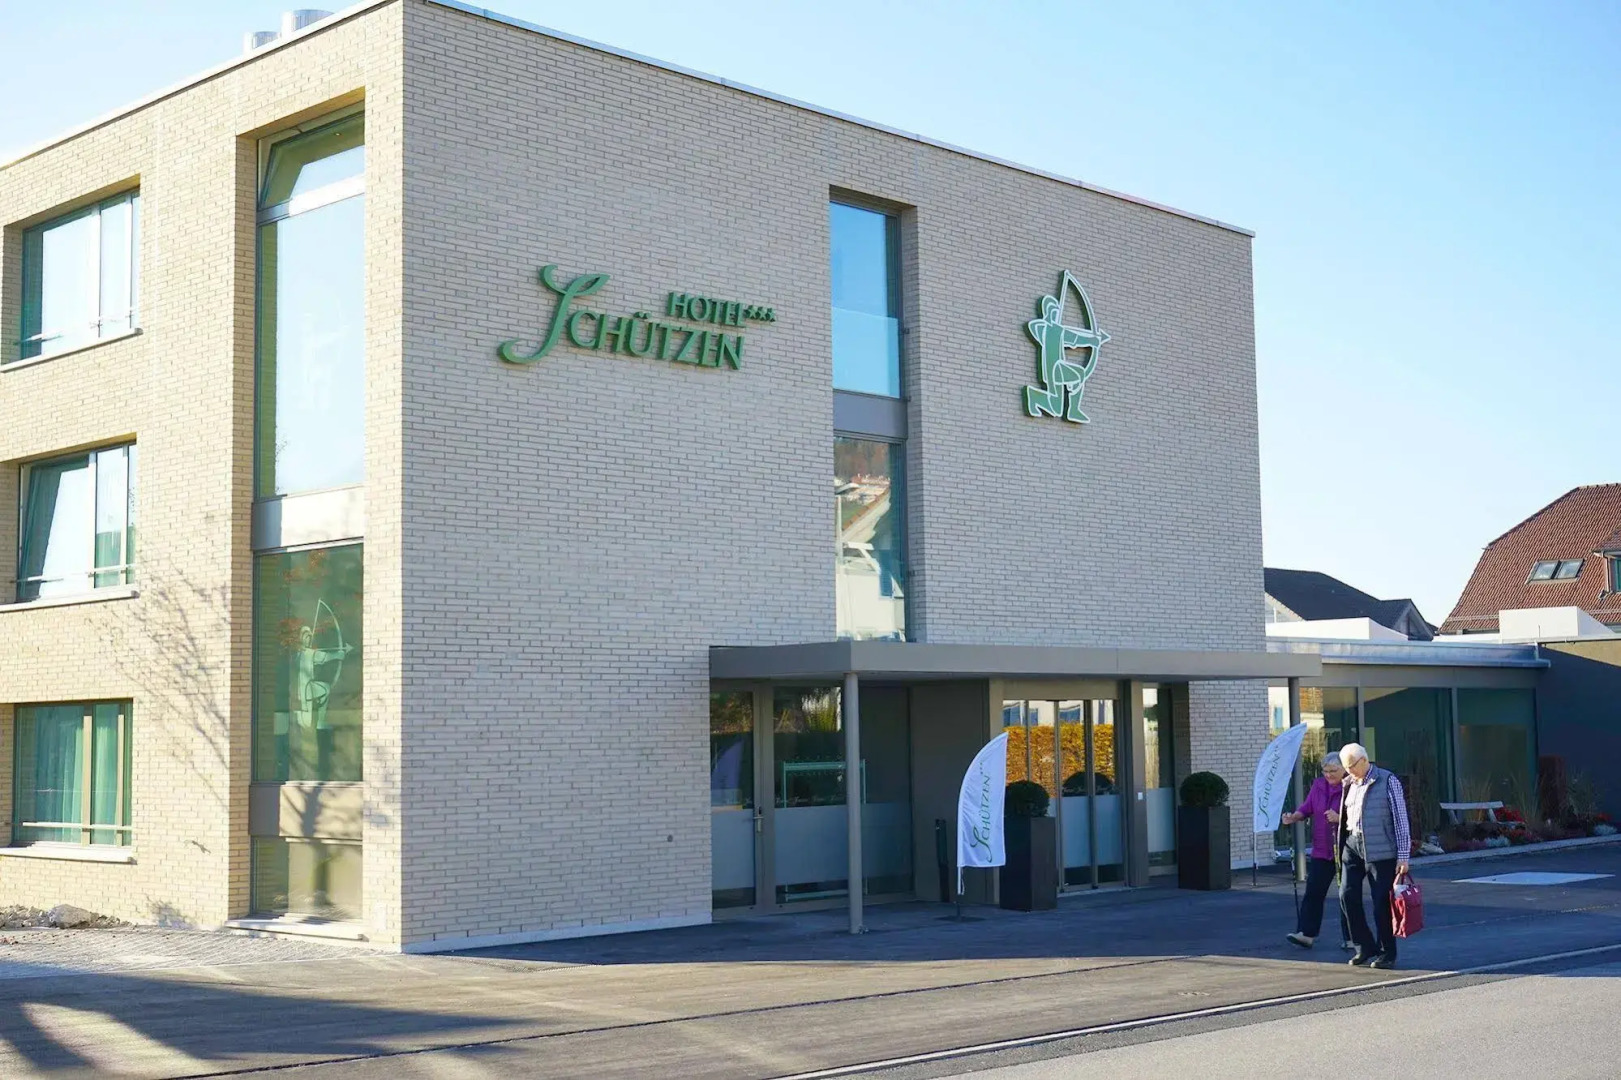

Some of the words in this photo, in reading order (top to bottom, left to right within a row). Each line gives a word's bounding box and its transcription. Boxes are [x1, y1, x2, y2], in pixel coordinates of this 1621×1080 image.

[498, 264, 744, 370] SCHÜTZEN
[667, 291, 746, 328] HOTEL
[970, 775, 993, 863] SCHÜTZEN
